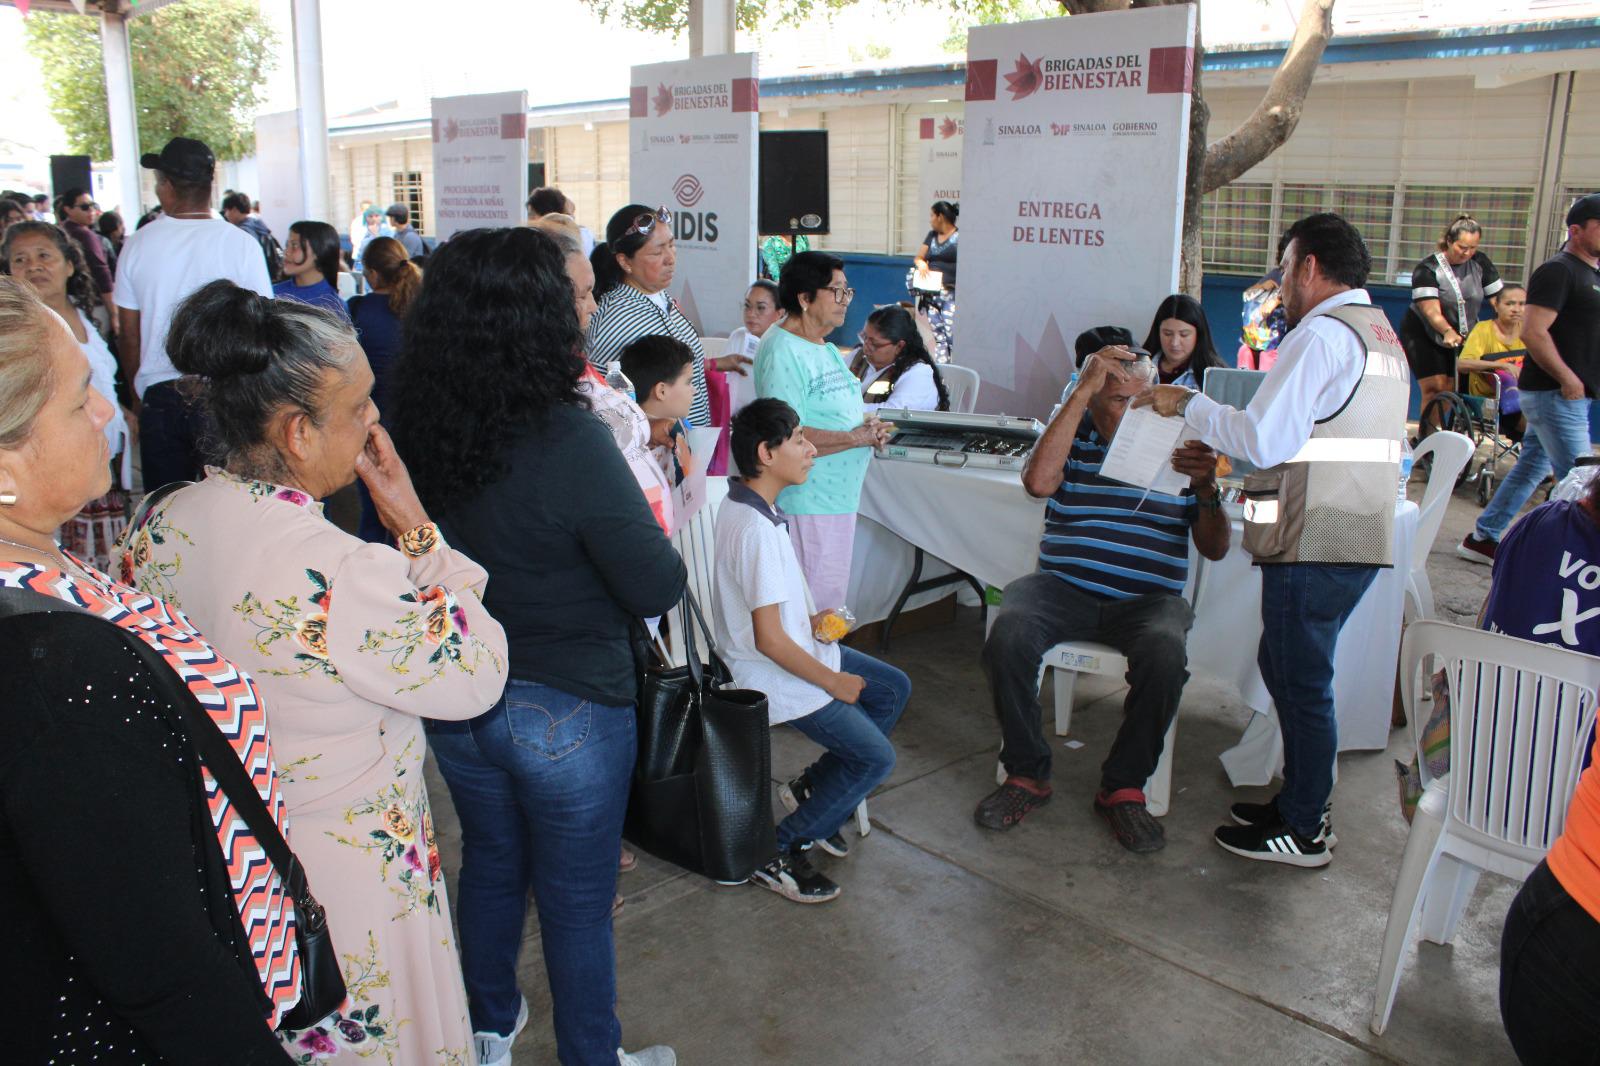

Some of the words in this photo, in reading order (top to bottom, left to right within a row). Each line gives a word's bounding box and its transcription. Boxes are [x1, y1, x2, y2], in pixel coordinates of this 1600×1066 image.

[1045, 56, 1113, 72] BRIGADAS
[1116, 54, 1142, 68] DEL
[1044, 70, 1142, 91] BIENESTAR
[674, 84, 712, 97] BRIGADAS
[714, 83, 728, 94] DEL
[674, 95, 728, 110] BIENESTAR
[998, 124, 1042, 135] SINALOA
[1052, 122, 1071, 136] DIF
[1072, 122, 1107, 131] SINALOA
[1112, 121, 1158, 131] GOBIERNO
[934, 190, 961, 199] ADULT
[1018, 201, 1102, 220] ENTREGA
[673, 211, 719, 243] IDIS
[1012, 226, 1035, 243] DE
[1039, 227, 1105, 247] LENTES
[1558, 550, 1600, 590] VO
